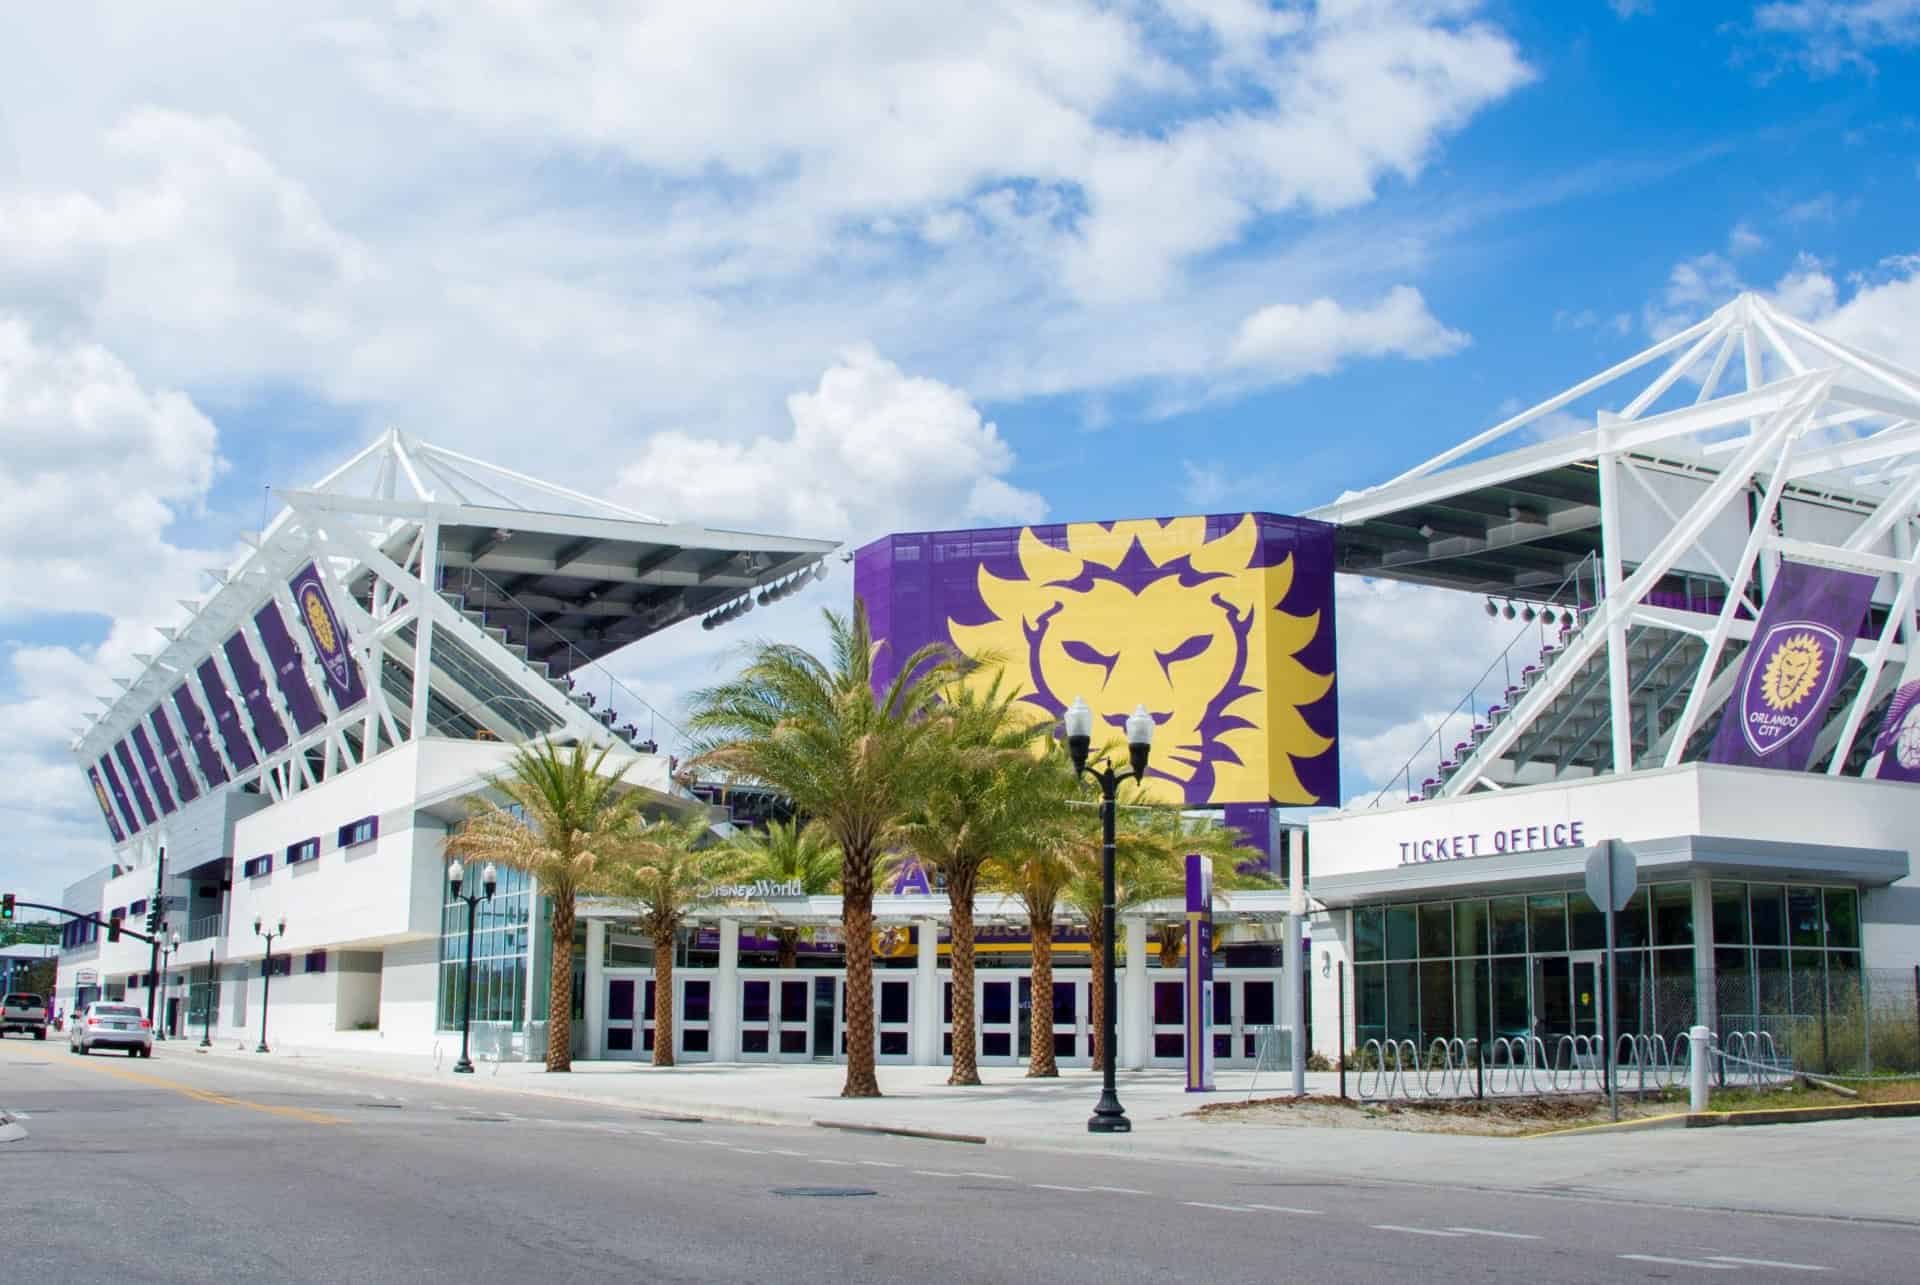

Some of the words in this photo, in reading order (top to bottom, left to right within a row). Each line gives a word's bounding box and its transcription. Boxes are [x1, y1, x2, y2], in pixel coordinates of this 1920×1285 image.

[1750, 711, 1798, 727] ORLANDO
[1758, 725, 1781, 737] CITY
[1400, 834, 1480, 865] TICKET
[1494, 821, 1585, 851] OFFICE
[755, 878, 801, 897] World
